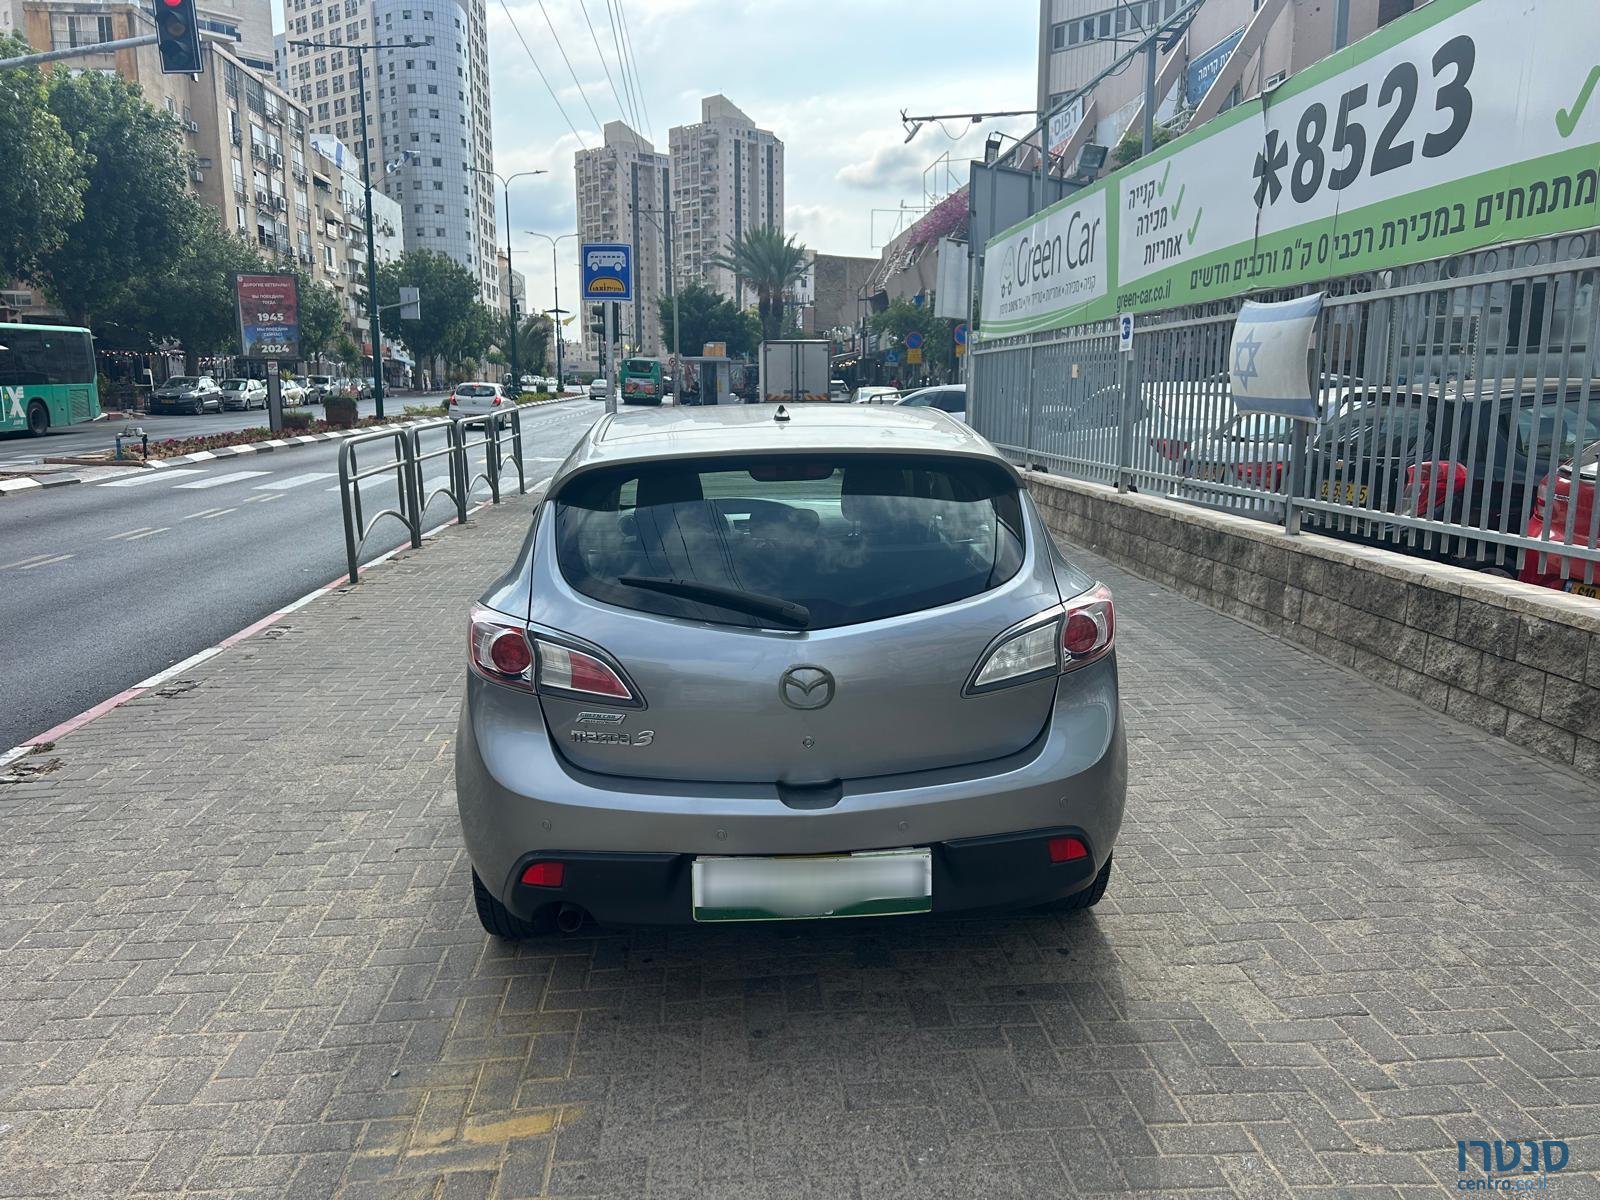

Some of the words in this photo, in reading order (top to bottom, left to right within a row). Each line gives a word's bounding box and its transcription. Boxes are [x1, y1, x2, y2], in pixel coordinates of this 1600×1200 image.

[1128, 182, 1155, 210] קנייה
[1136, 206, 1168, 237] מכירה
[1379, 203, 1465, 252] במכירת
[1017, 236, 1062, 287] Green
[1066, 210, 1100, 270] Car
[1143, 233, 1183, 266] אחריות
[1281, 238, 1312, 271] ק"מ
[1317, 233, 1329, 264] 0
[1334, 227, 1374, 260] רכבי
[1190, 262, 1230, 290] חדשים
[1233, 250, 1278, 281] ורכבים
[1116, 279, 1172, 313] green-car.co.il
[257, 312, 284, 322] 1945
[261, 344, 290, 353] 2024
[571, 729, 631, 746] mazda
[633, 730, 655, 746] 3
